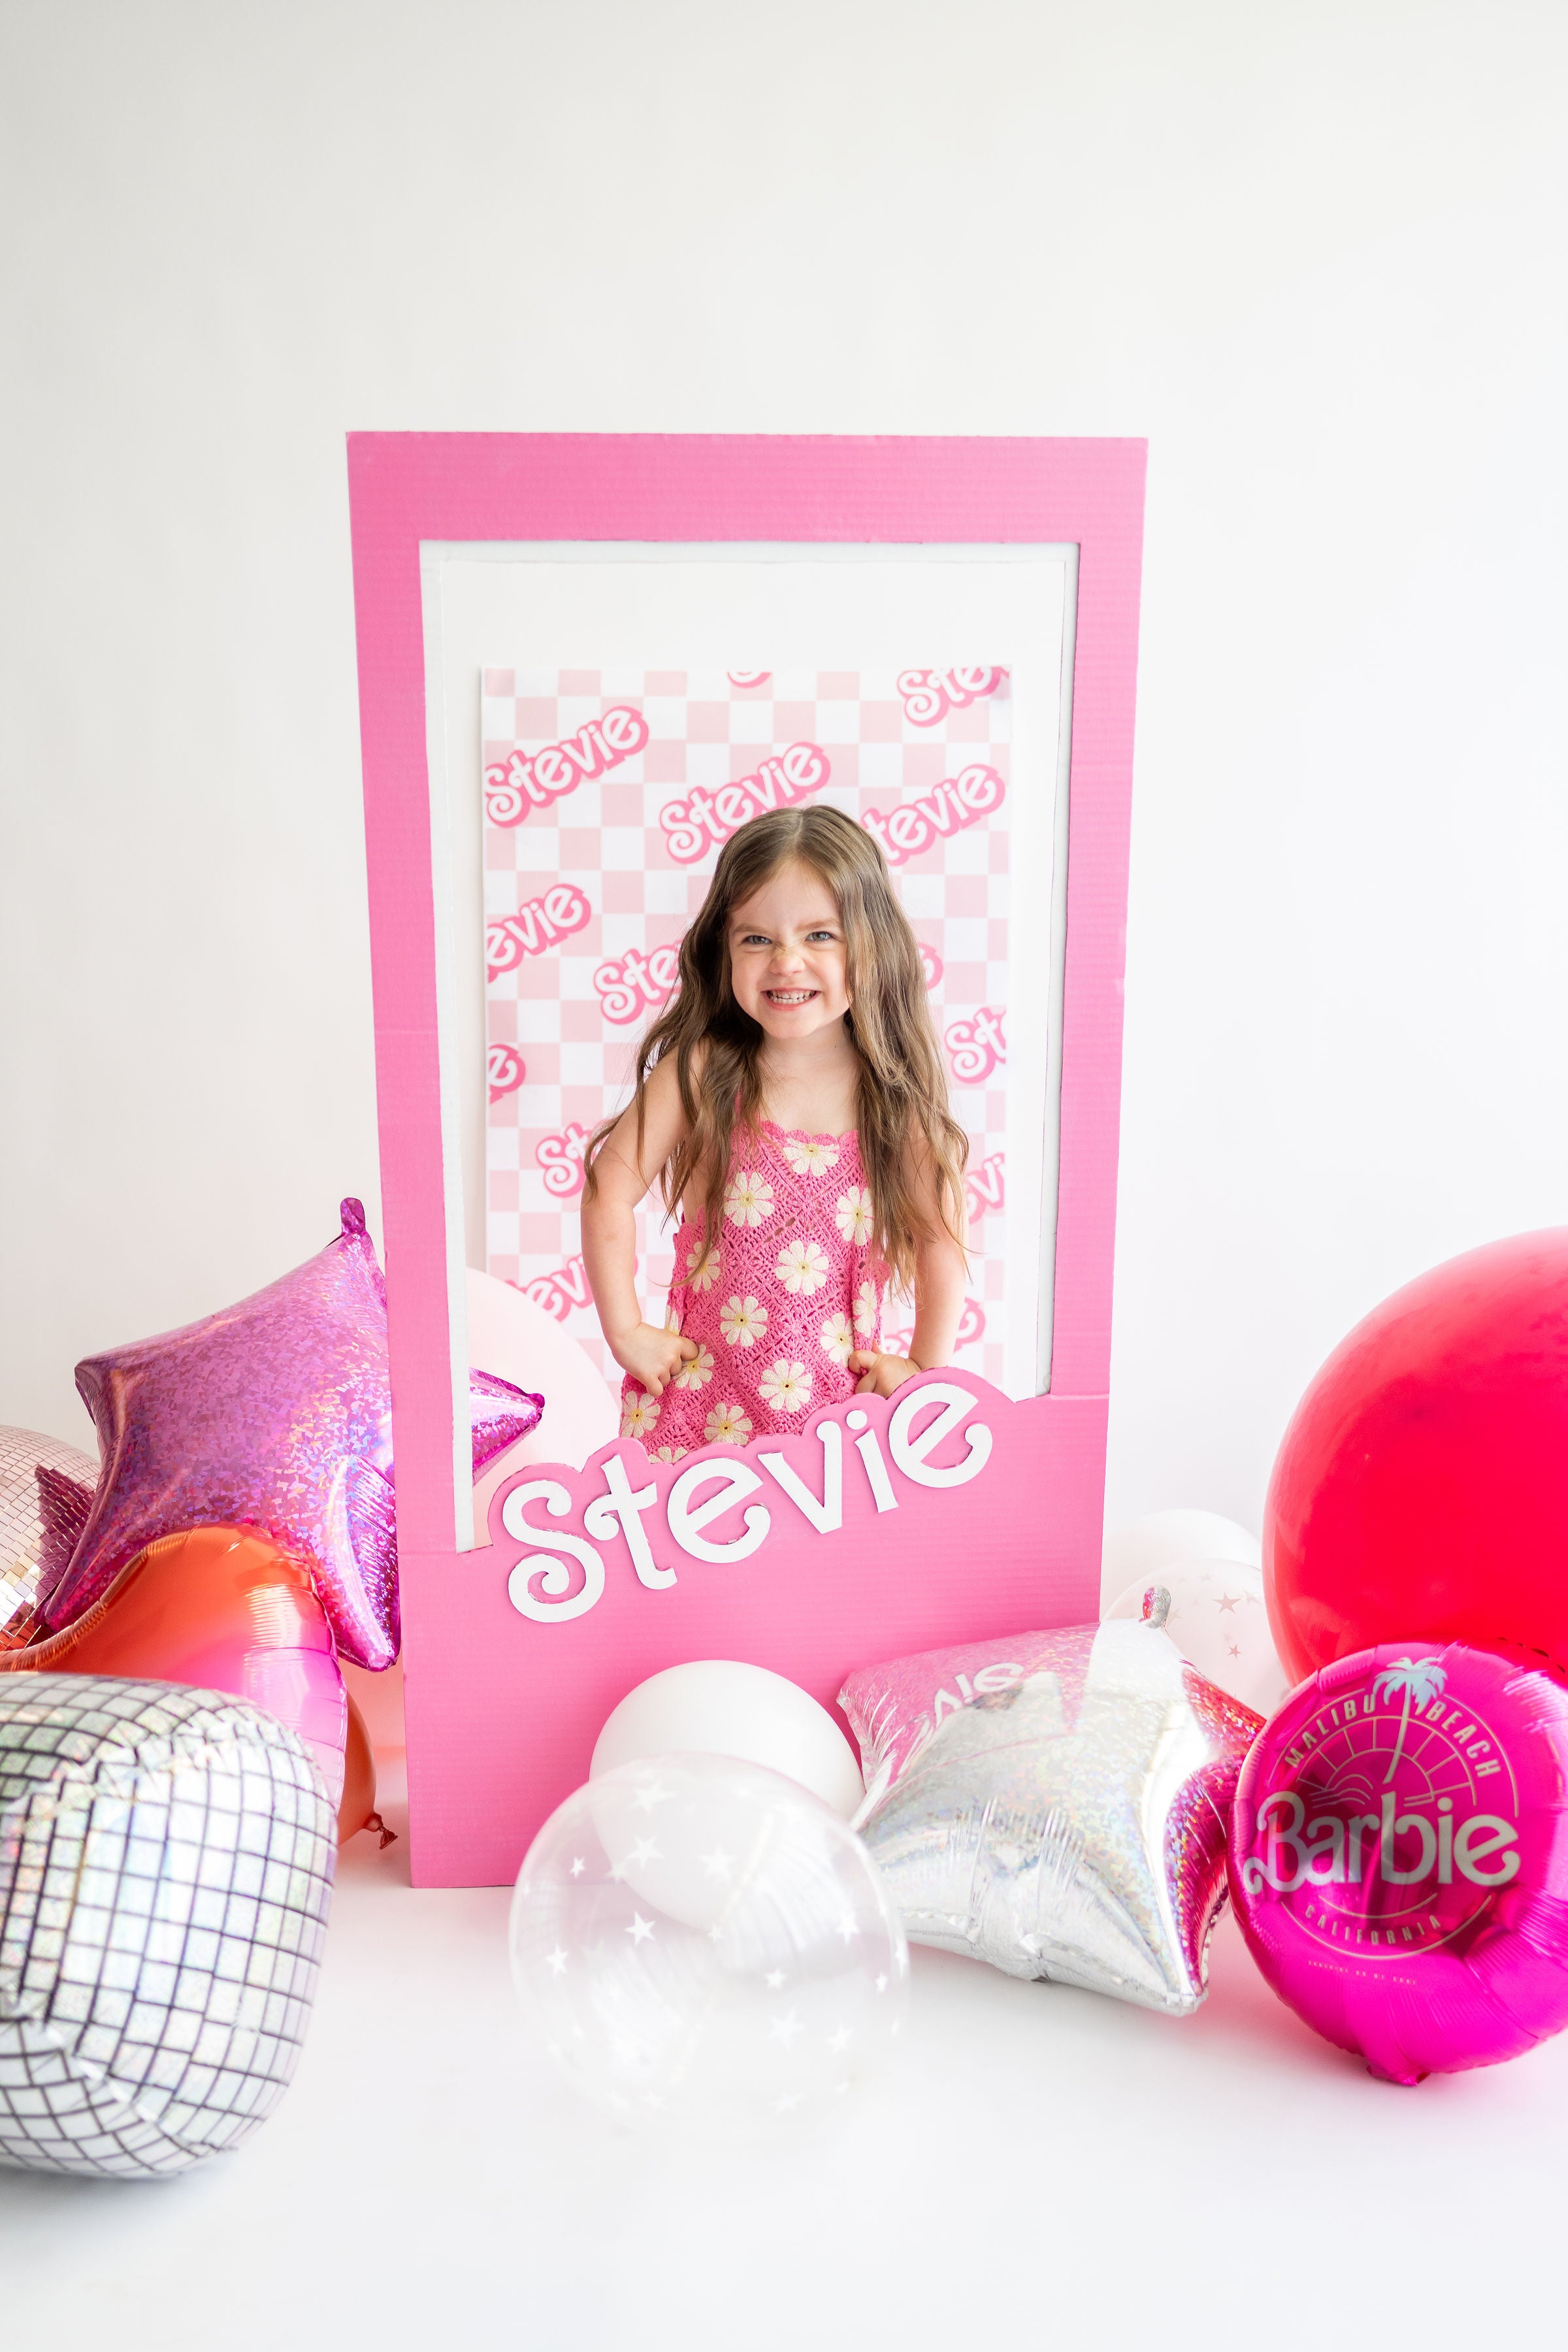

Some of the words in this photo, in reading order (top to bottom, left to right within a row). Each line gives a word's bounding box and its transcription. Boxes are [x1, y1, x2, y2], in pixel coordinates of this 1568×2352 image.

[898, 666, 1009, 727] Ste
[485, 706, 649, 828] Stevie
[660, 742, 830, 864] Stevie
[858, 764, 1005, 866] tevie
[593, 939, 683, 1025] Ste
[502, 1382, 993, 1623] Stevie
[1284, 1693, 1376, 1769] MALIBU
[1425, 1701, 1501, 1778] BEACH
[1243, 1791, 1521, 1895] Barbie
[1305, 1904, 1441, 1945] CALIFORNIA
